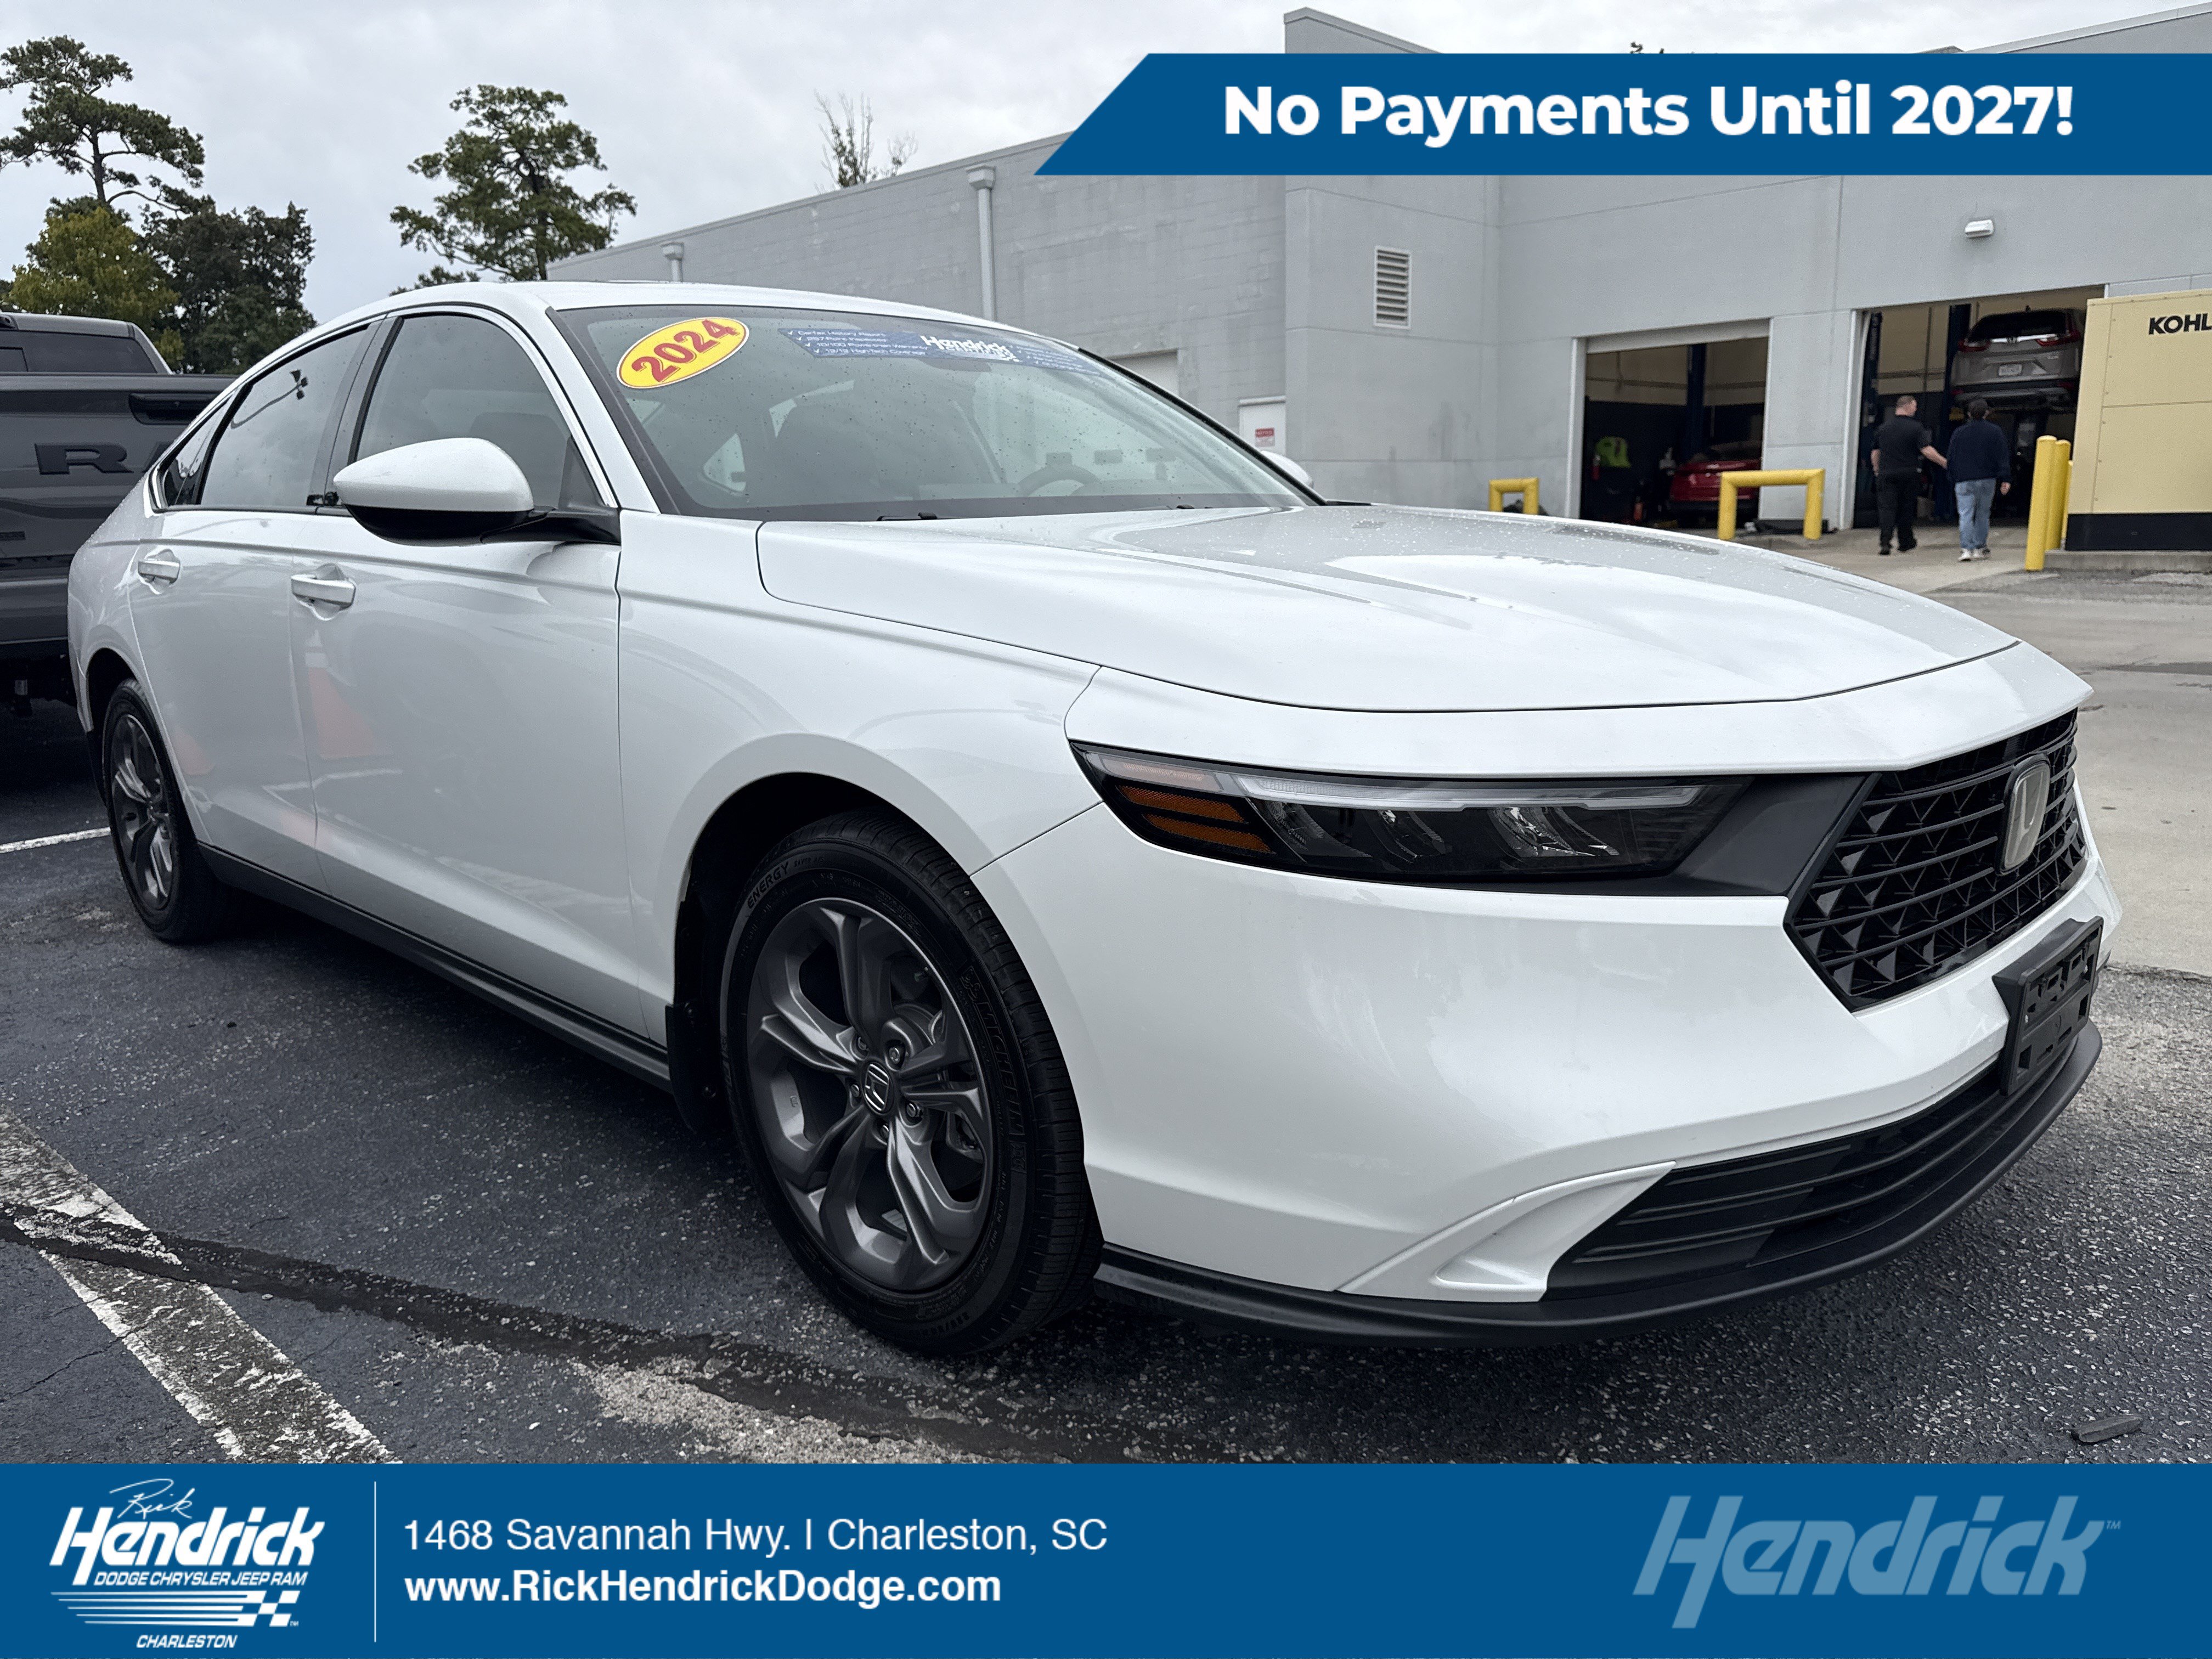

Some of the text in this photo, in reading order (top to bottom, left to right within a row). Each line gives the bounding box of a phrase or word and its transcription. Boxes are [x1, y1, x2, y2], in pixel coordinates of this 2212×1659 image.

[2148, 313, 2212, 335] KOHL
[631, 319, 740, 382] 2024
[920, 335, 1011, 358] Hendrick
[747, 861, 789, 910] ENERGY
